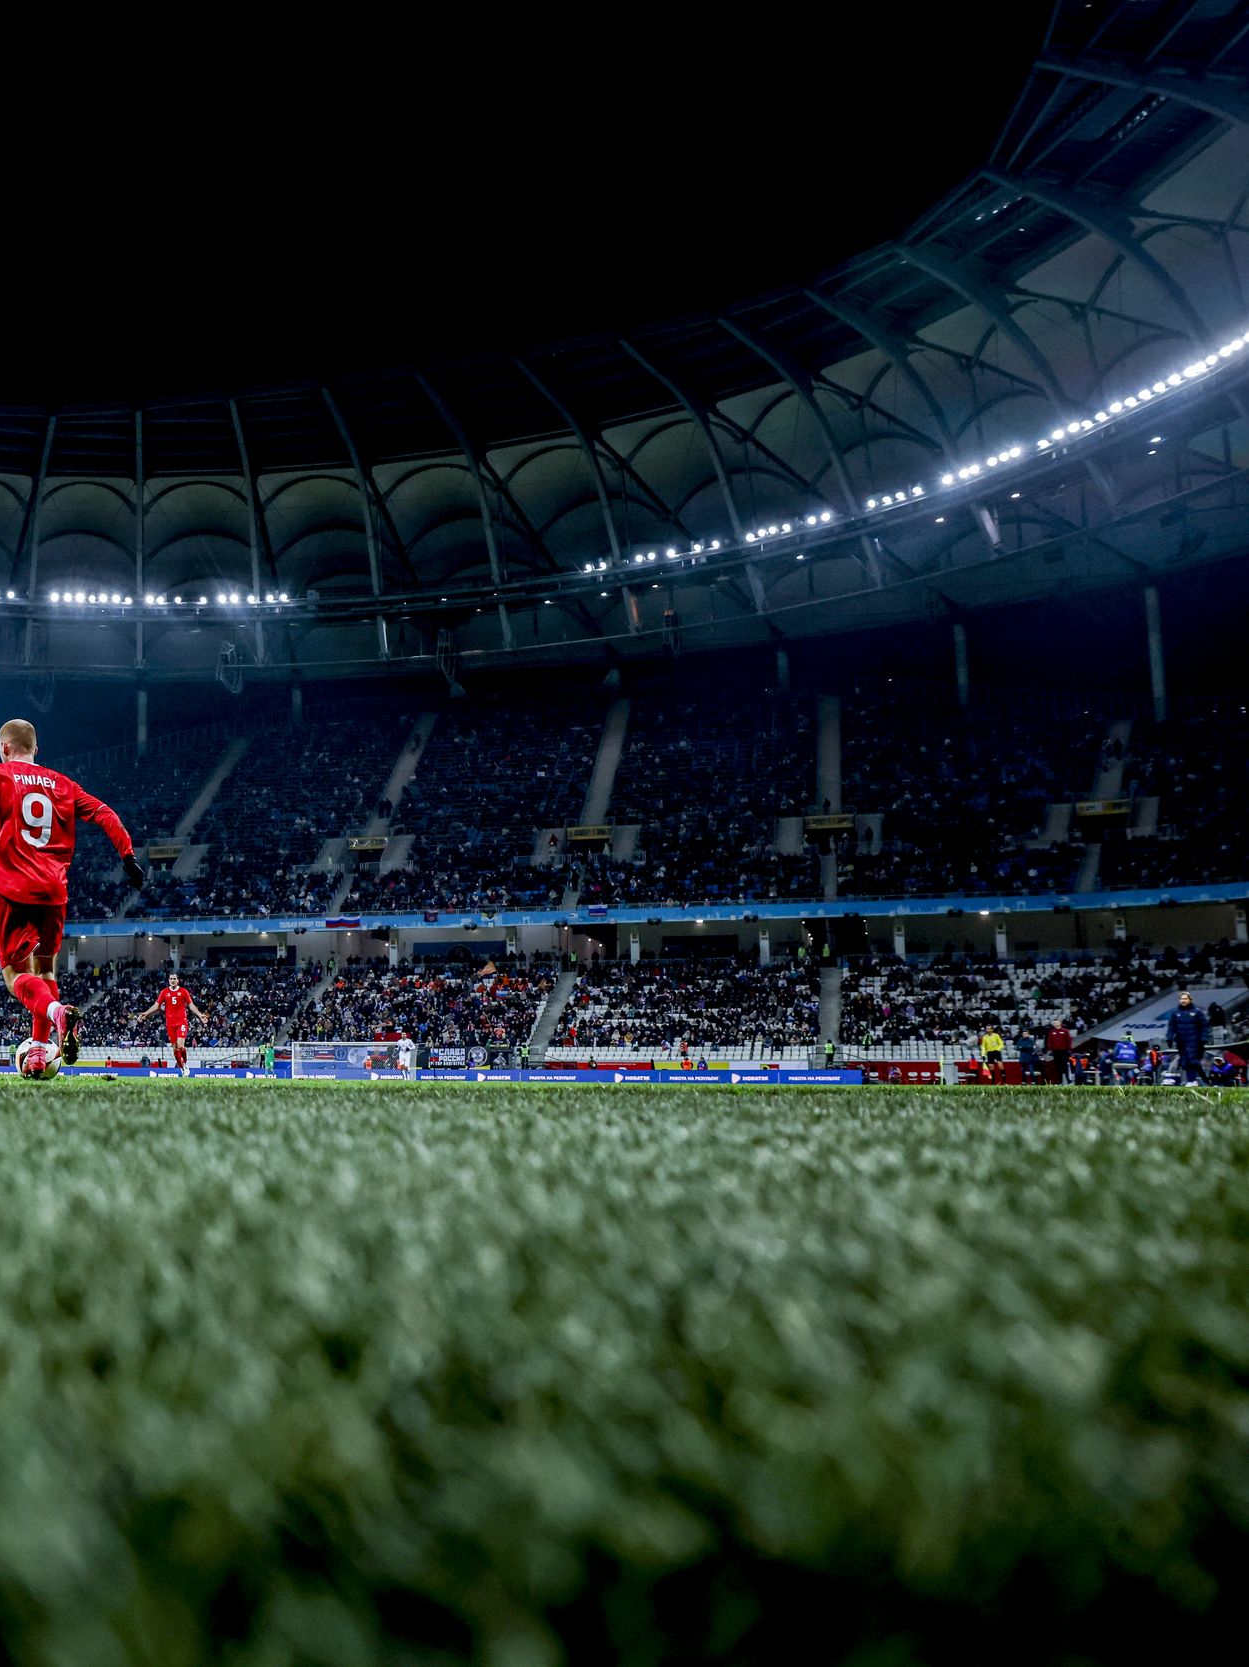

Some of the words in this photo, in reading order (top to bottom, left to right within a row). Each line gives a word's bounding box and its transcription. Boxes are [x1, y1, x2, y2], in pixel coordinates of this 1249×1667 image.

[13, 773, 56, 790] PINIAEV
[20, 792, 53, 848] 9
[171, 996, 177, 1005] 5
[438, 1048, 466, 1056] СЛАВА
